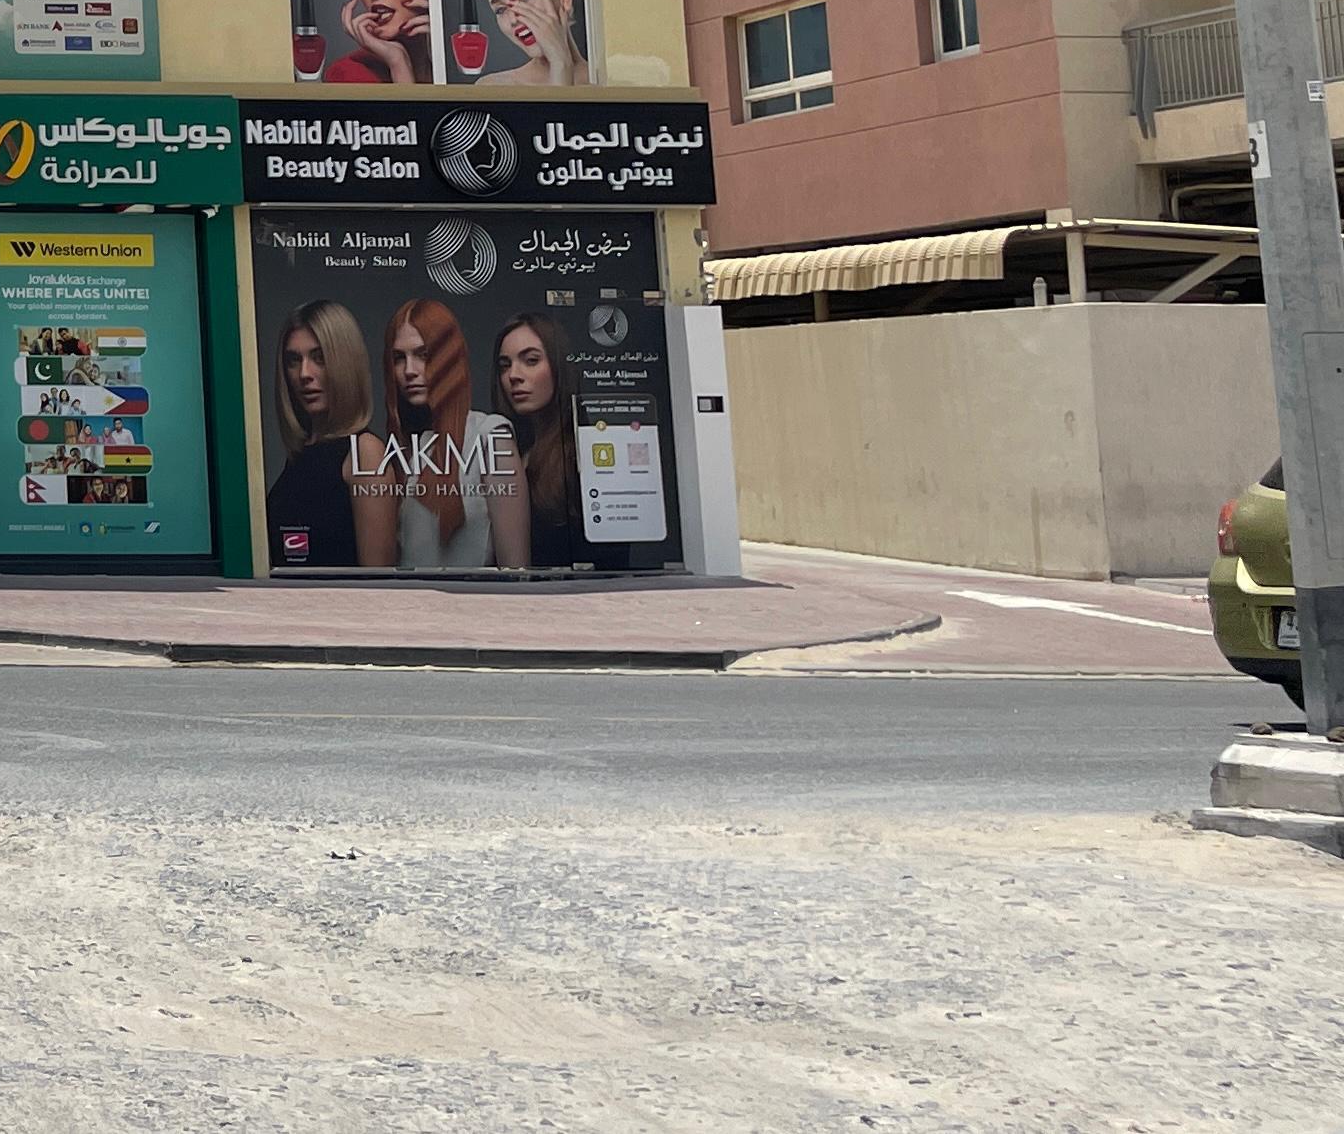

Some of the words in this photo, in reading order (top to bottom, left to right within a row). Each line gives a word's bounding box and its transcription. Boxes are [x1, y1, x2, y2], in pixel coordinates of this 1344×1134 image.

[38, 116, 233, 153] جويالوكاس
[245, 119, 323, 146] Nabiid
[326, 120, 418, 151] Aljamal
[531, 122, 631, 155] الجمال
[633, 124, 705, 156] نبض
[39, 156, 158, 189] للصرافة
[266, 156, 348, 184] Beauty
[353, 156, 420, 179] Salon
[535, 159, 603, 187] صالون
[606, 161, 674, 191] بيوتي
[40, 243, 99, 257] Western
[100, 244, 142, 257] Union
[273, 232, 331, 248] Nabiid
[341, 232, 412, 251] Aljamal
[519, 227, 581, 257] الجمال
[585, 232, 631, 257] نبض
[324, 255, 367, 269] Beauty
[372, 255, 407, 268] Salon
[512, 256, 556, 273] صالون
[557, 257, 596, 275] بيوتي
[27, 274, 86, 286] Joyalukkas
[86, 276, 127, 288] Exchange
[1, 287, 54, 299] WHERE
[56, 288, 101, 299] FLAGS
[104, 288, 150, 300] UNITE!
[27, 302, 53, 312] global
[54, 304, 82, 312] money
[116, 303, 149, 311] solution
[614, 370, 648, 379] Aljamal
[352, 483, 428, 497] INSPIRED
[435, 482, 518, 497] HAIRCARE
